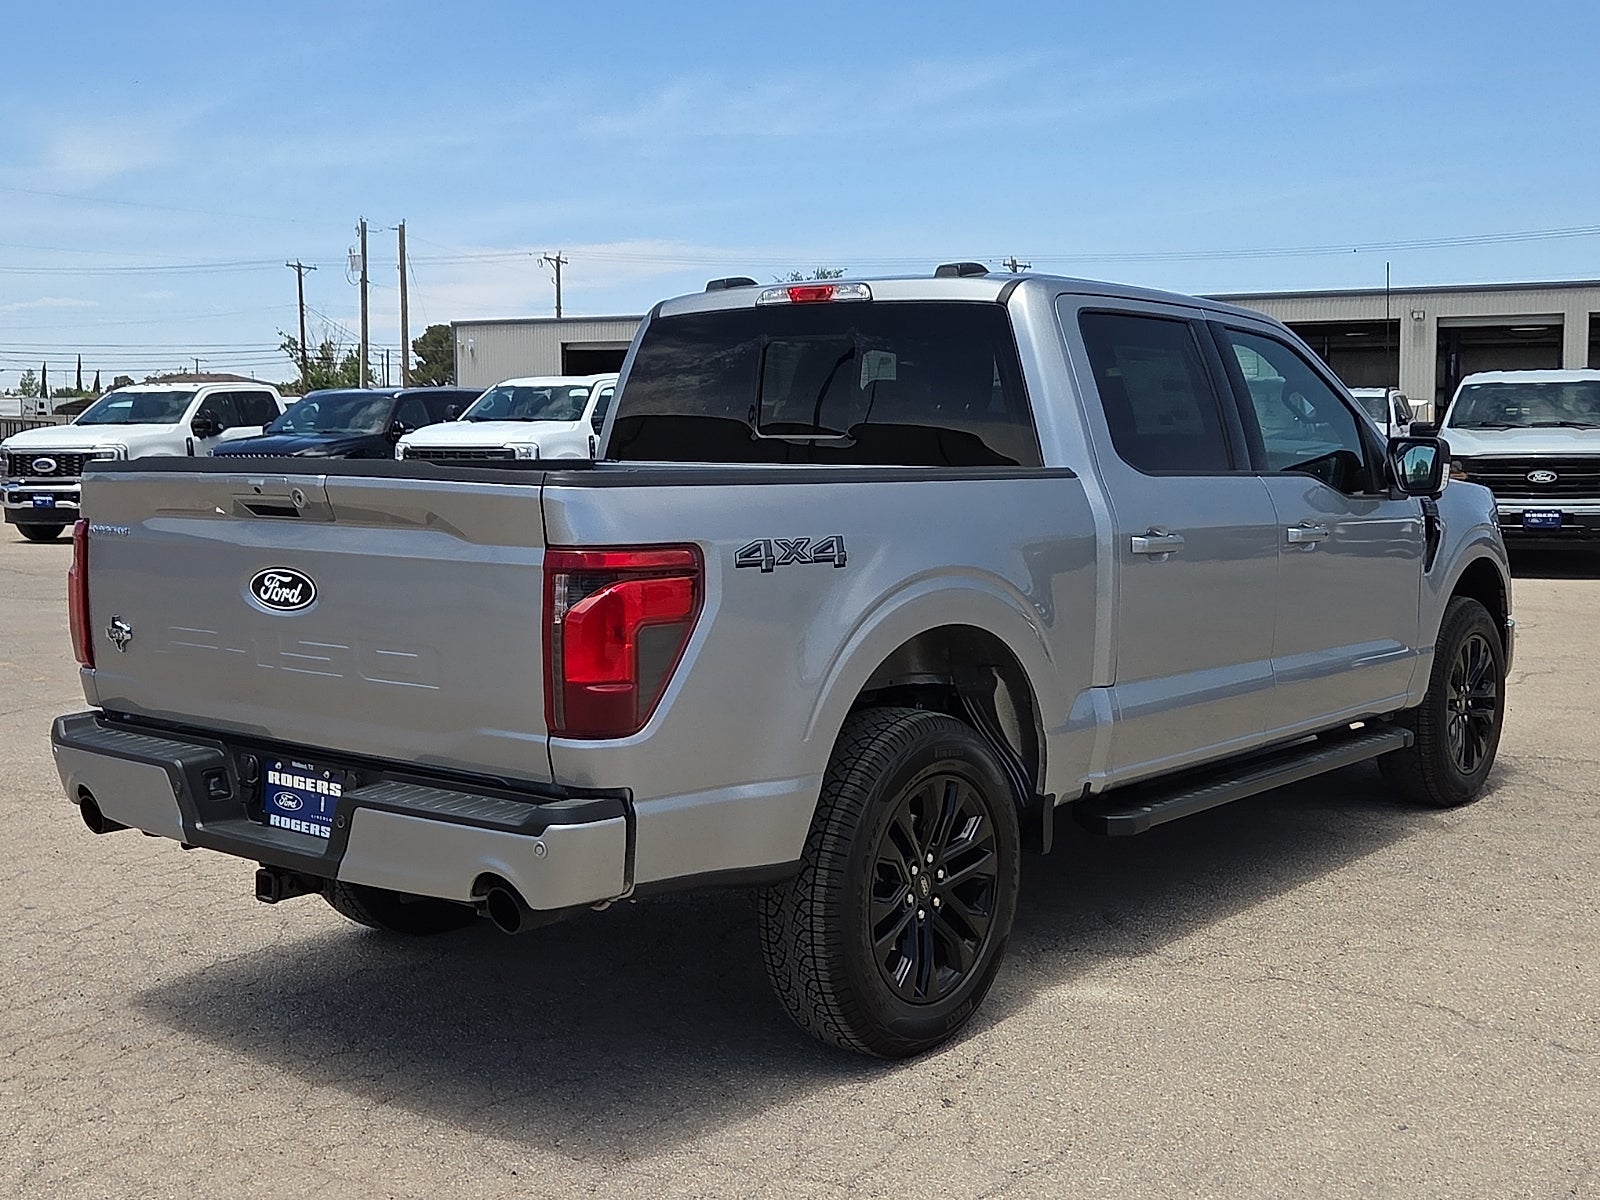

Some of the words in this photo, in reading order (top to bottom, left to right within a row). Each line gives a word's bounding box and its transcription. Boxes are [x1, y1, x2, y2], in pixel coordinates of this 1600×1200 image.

[260, 573, 303, 603] Ford
[267, 770, 342, 798] ROGERS
[278, 793, 299, 809] Ford
[269, 813, 332, 839] ROGERS
